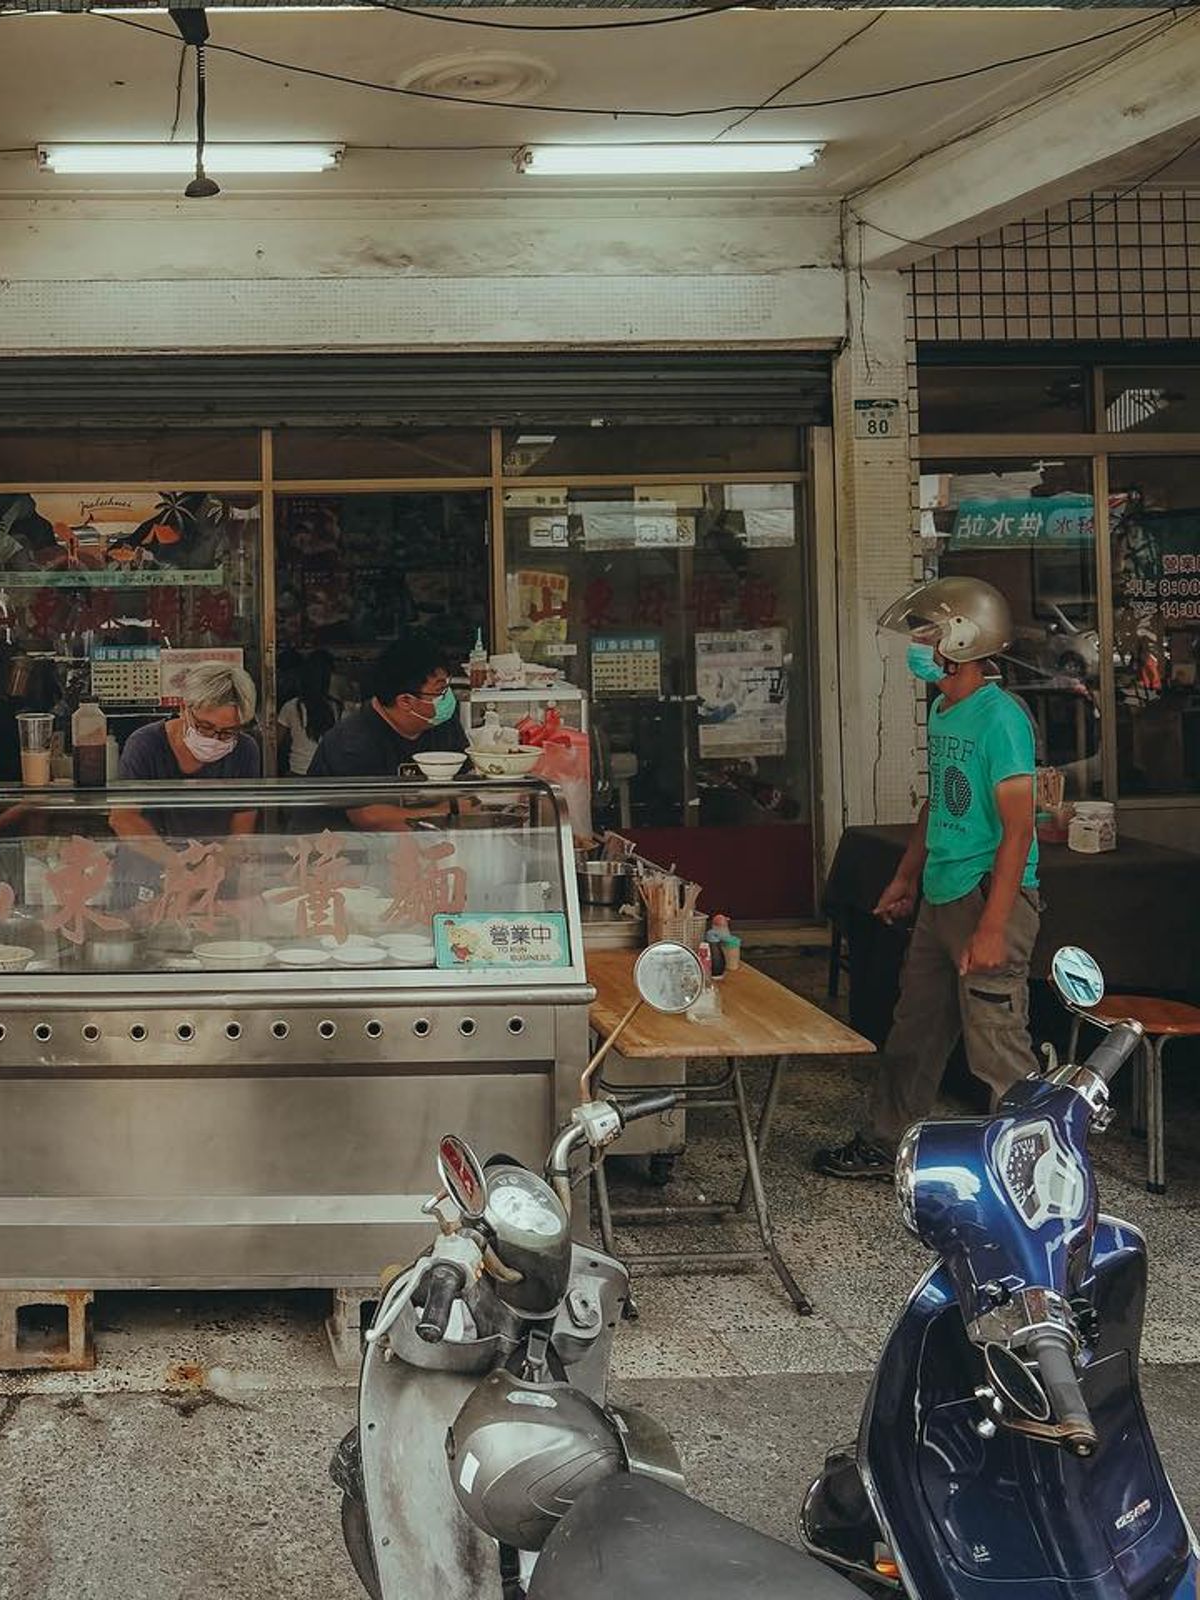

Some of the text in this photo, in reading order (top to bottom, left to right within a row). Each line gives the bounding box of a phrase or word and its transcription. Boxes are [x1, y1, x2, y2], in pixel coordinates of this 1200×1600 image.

[868, 419, 888, 434] 80
[1162, 554, 1200, 574] 營業
[489, 924, 551, 946] 營業中
